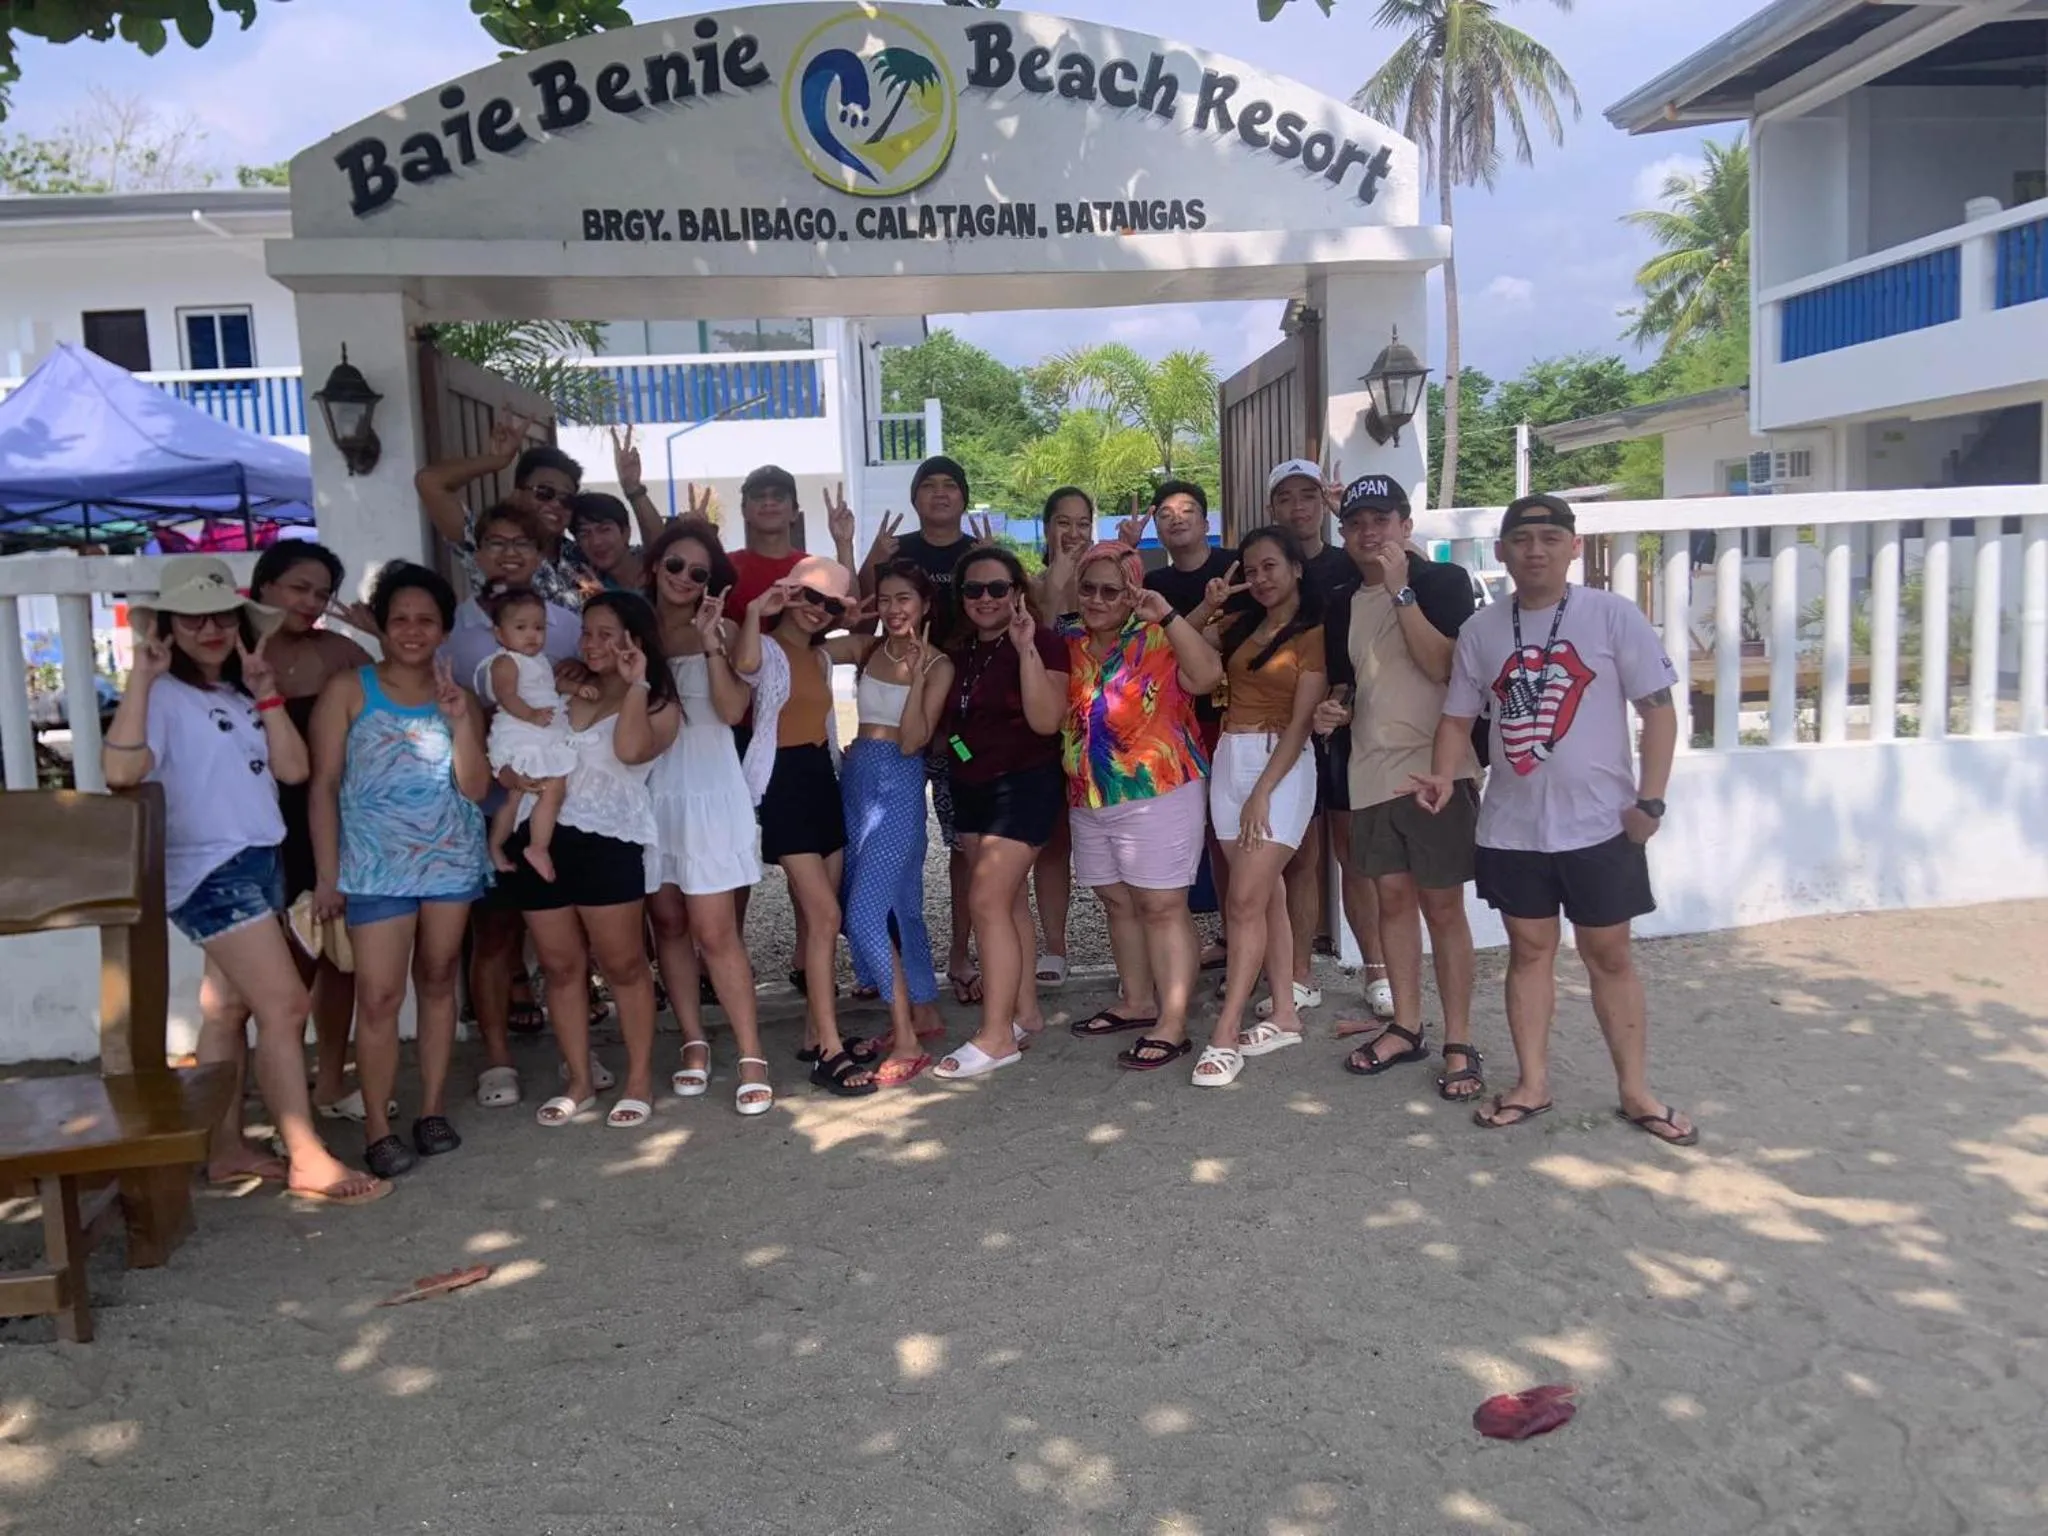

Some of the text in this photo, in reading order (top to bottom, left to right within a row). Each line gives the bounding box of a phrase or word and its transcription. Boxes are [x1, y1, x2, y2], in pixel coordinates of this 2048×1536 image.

[335, 18, 1394, 217] Baie Benie Beach Resort
[582, 207, 672, 241] BRGY.
[1055, 198, 1206, 234] BATANGAS
[1343, 479, 1389, 507] JAPAN
